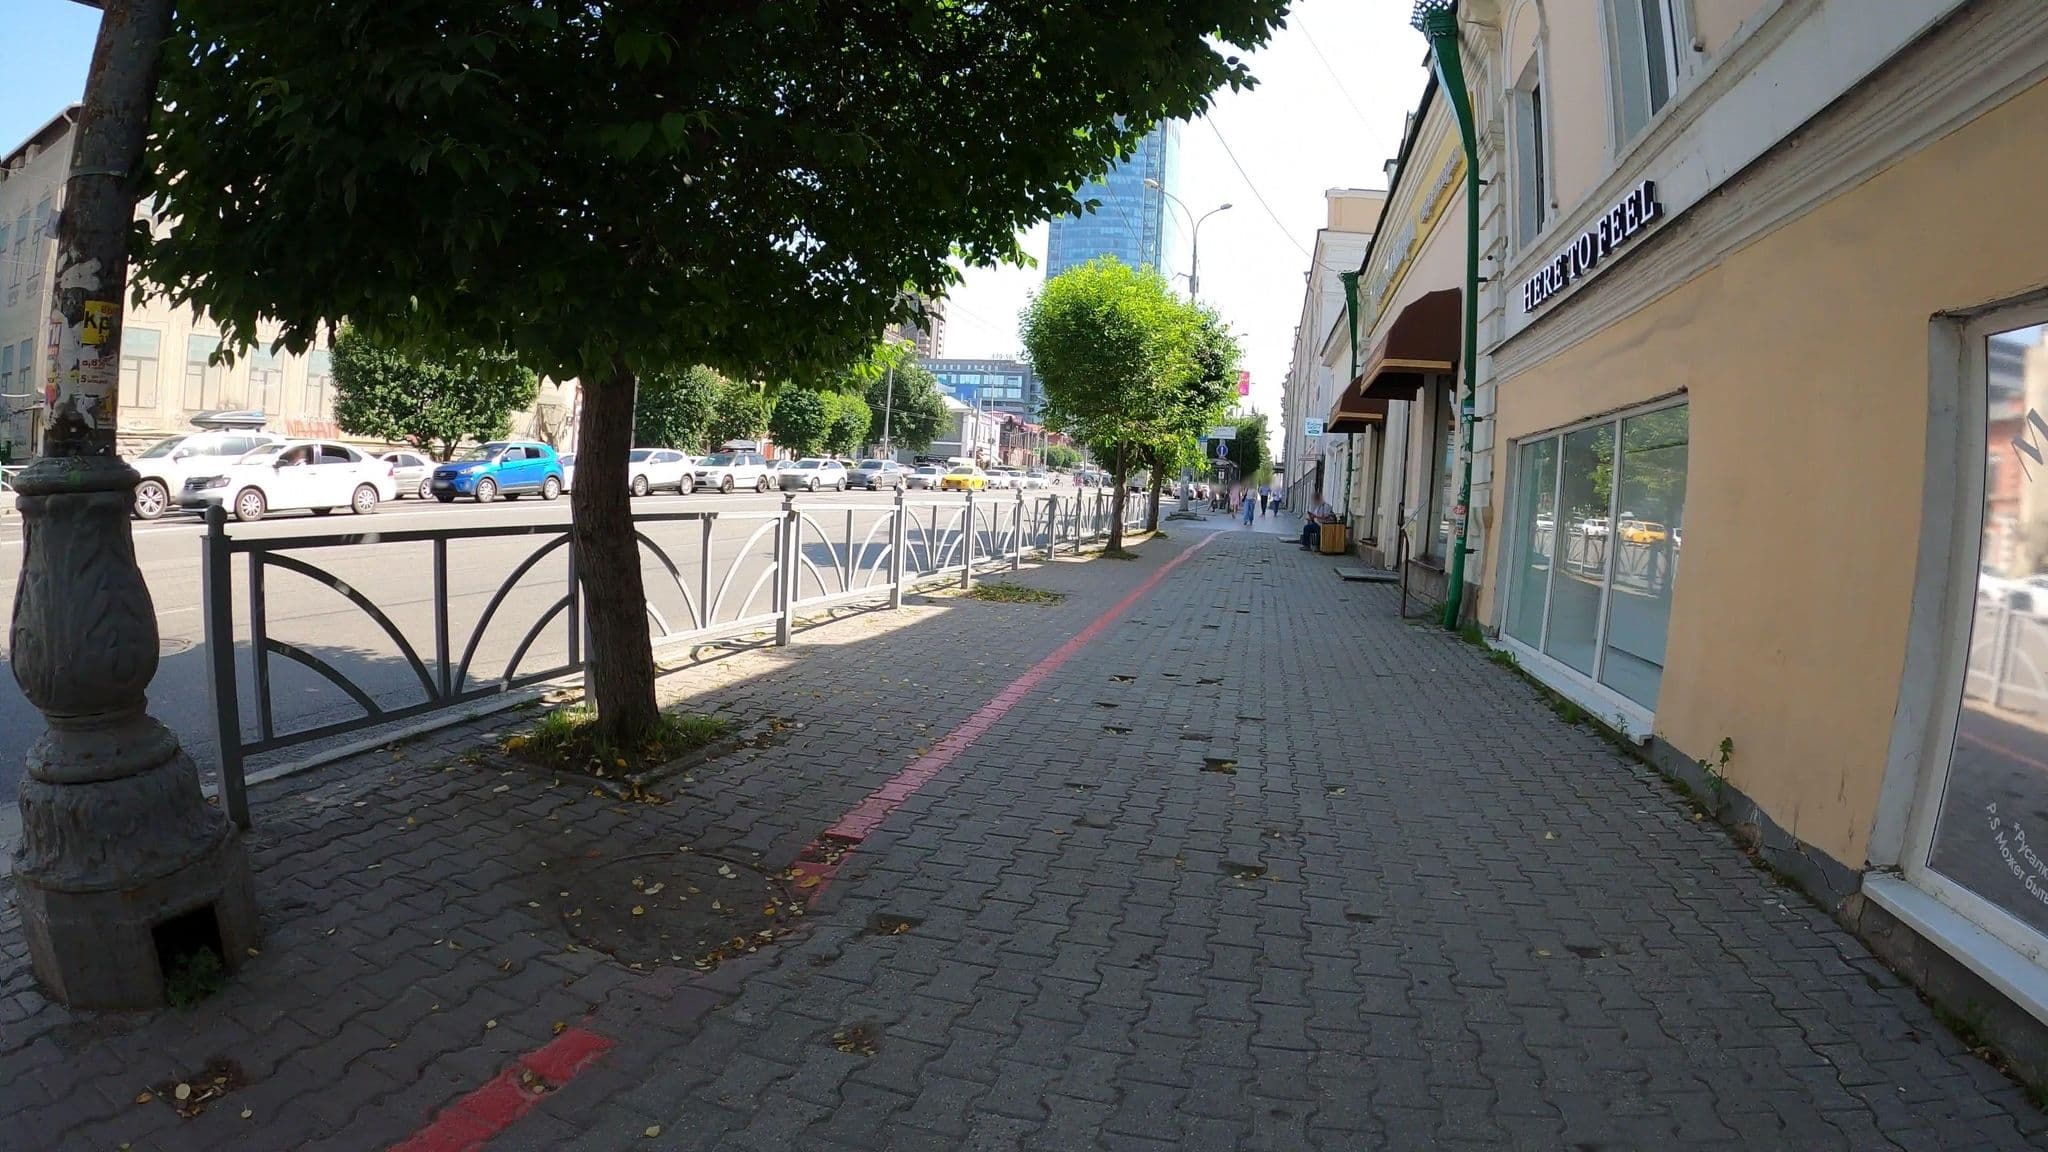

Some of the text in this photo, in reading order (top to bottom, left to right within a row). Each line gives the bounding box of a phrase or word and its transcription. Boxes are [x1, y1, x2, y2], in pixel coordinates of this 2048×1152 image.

[1523, 180, 1664, 313] HERE TO FEEL
[1995, 831, 2025, 880] Может
